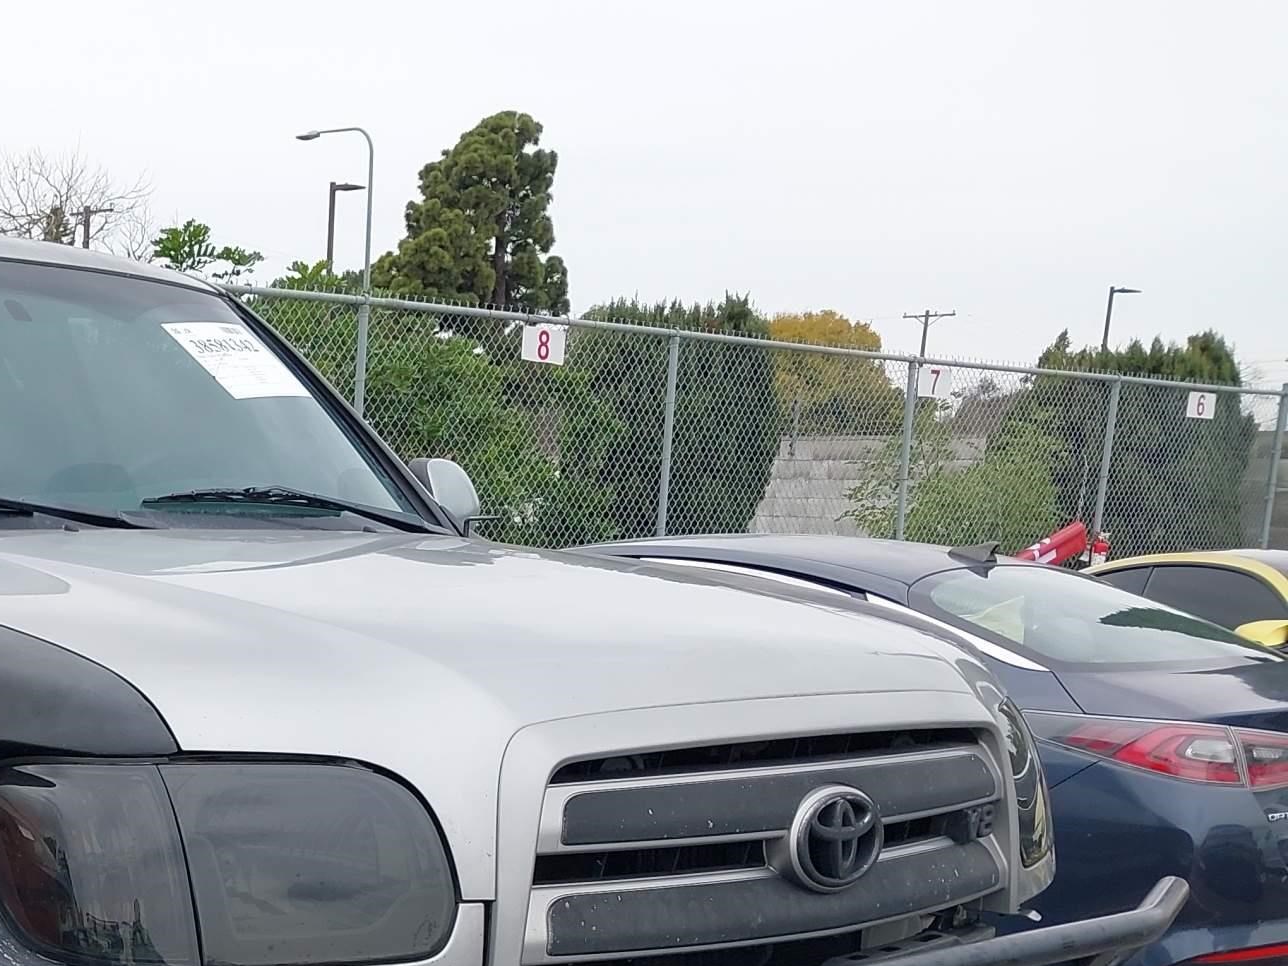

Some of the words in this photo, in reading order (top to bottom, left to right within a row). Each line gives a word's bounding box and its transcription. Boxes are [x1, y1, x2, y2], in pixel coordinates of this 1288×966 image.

[189, 338, 259, 353] 38581342
[538, 330, 550, 360] 8
[931, 369, 941, 395] 7
[1197, 394, 1206, 416] 6
